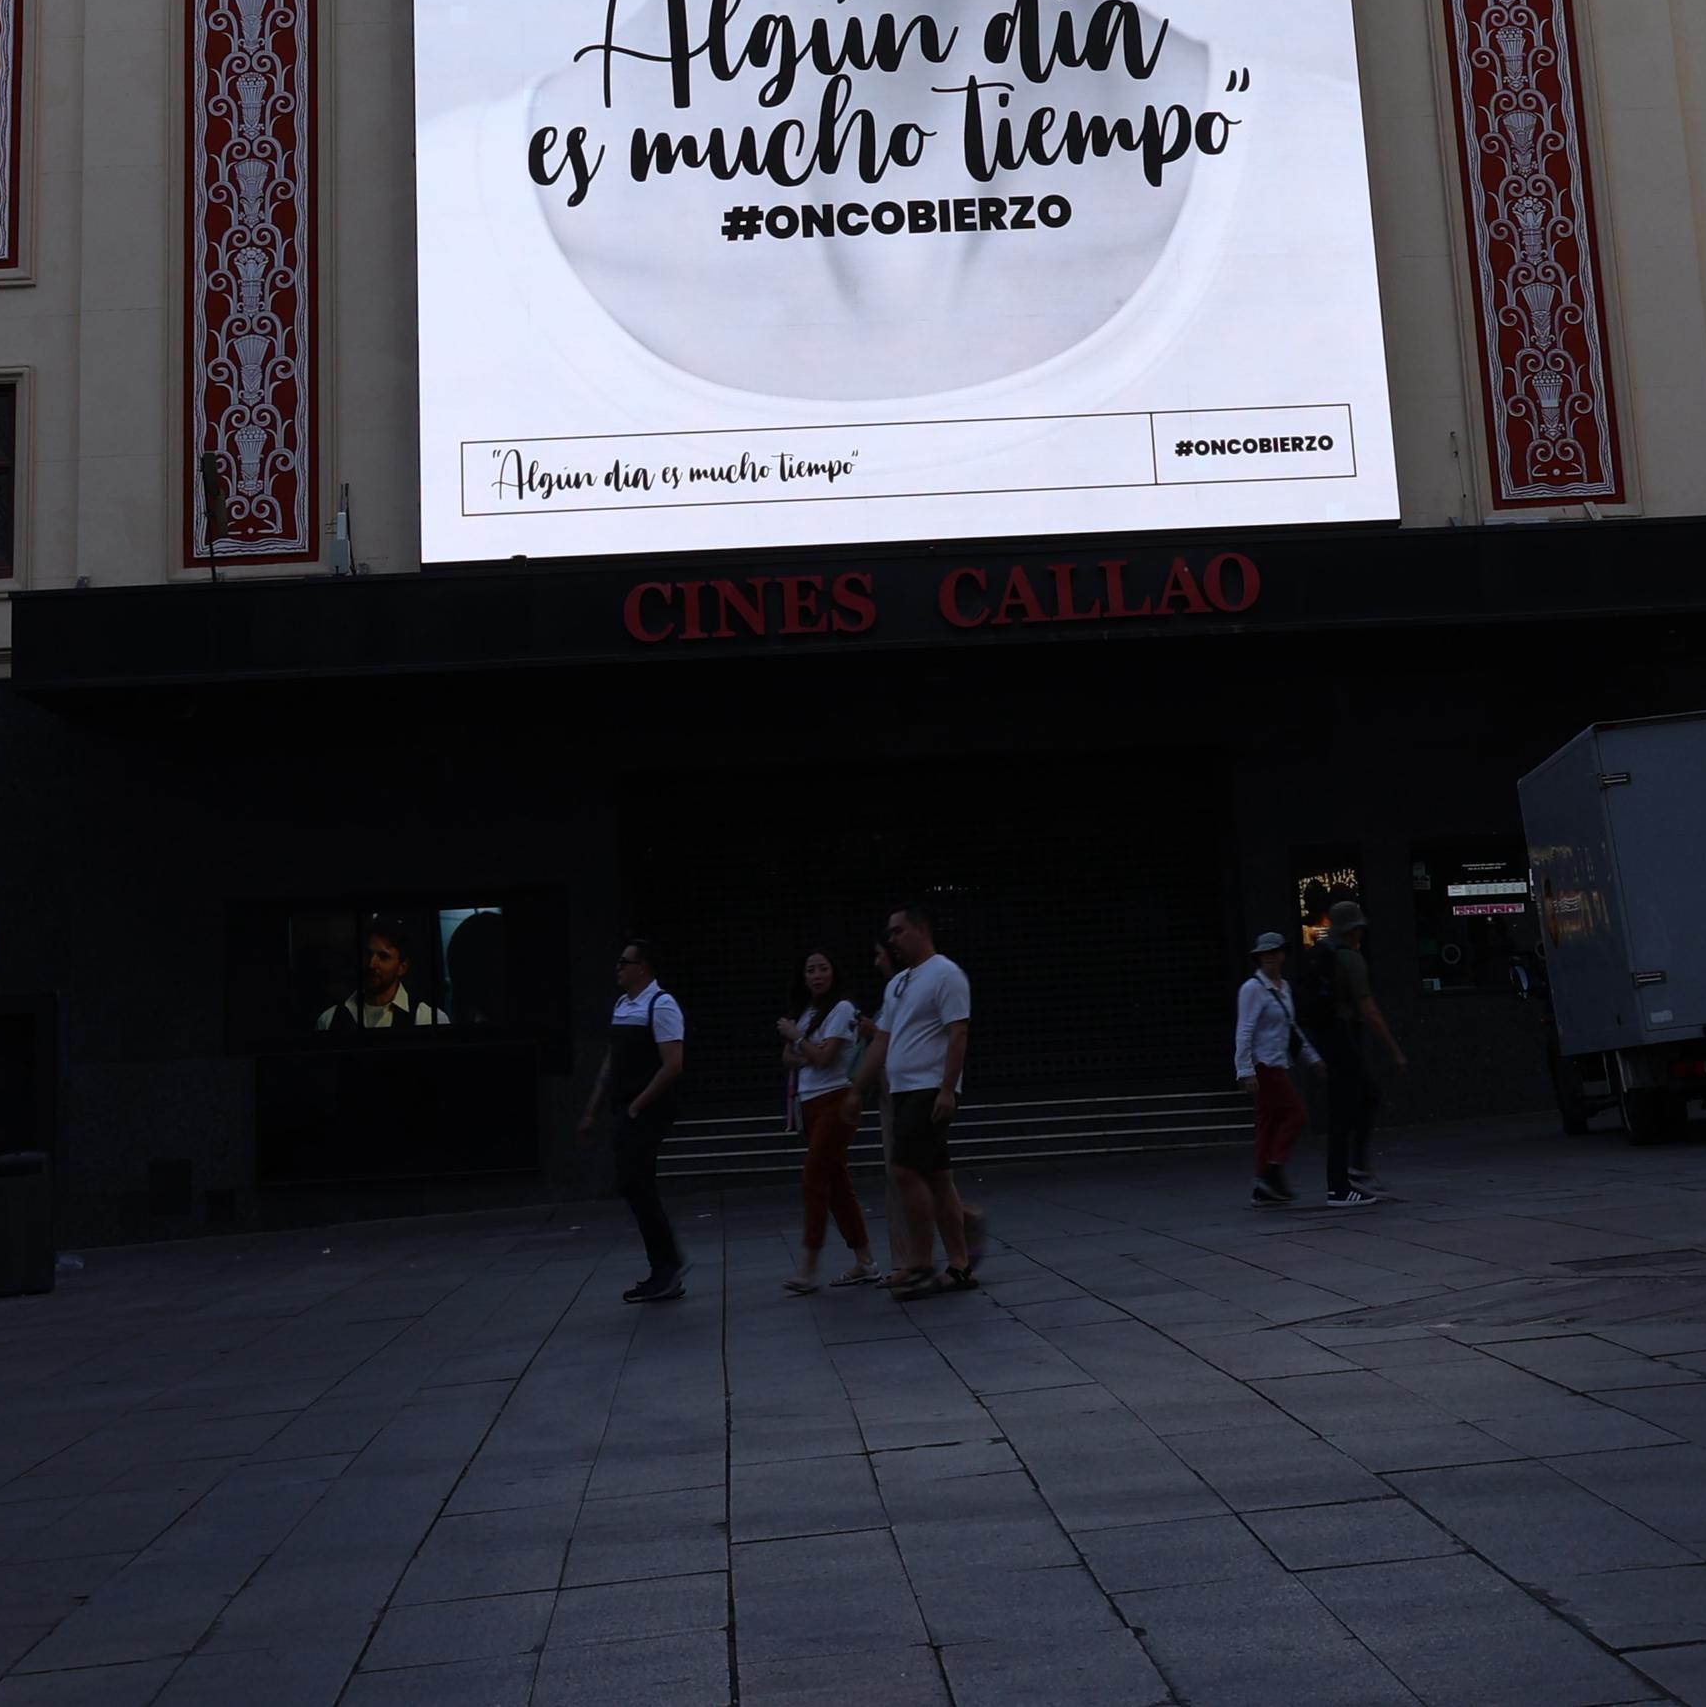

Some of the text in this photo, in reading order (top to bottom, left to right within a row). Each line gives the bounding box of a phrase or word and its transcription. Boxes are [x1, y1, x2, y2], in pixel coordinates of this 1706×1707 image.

[528, 126, 606, 208] es
[630, 74, 939, 188] mucho
[721, 195, 1072, 241] #ONCOBIERZO
[1174, 435, 1334, 457] #ONCOBIERZO
[603, 459, 655, 492] día
[661, 466, 683, 490] es
[689, 451, 772, 484] mucho
[622, 552, 1261, 642] CINES CALLAO
